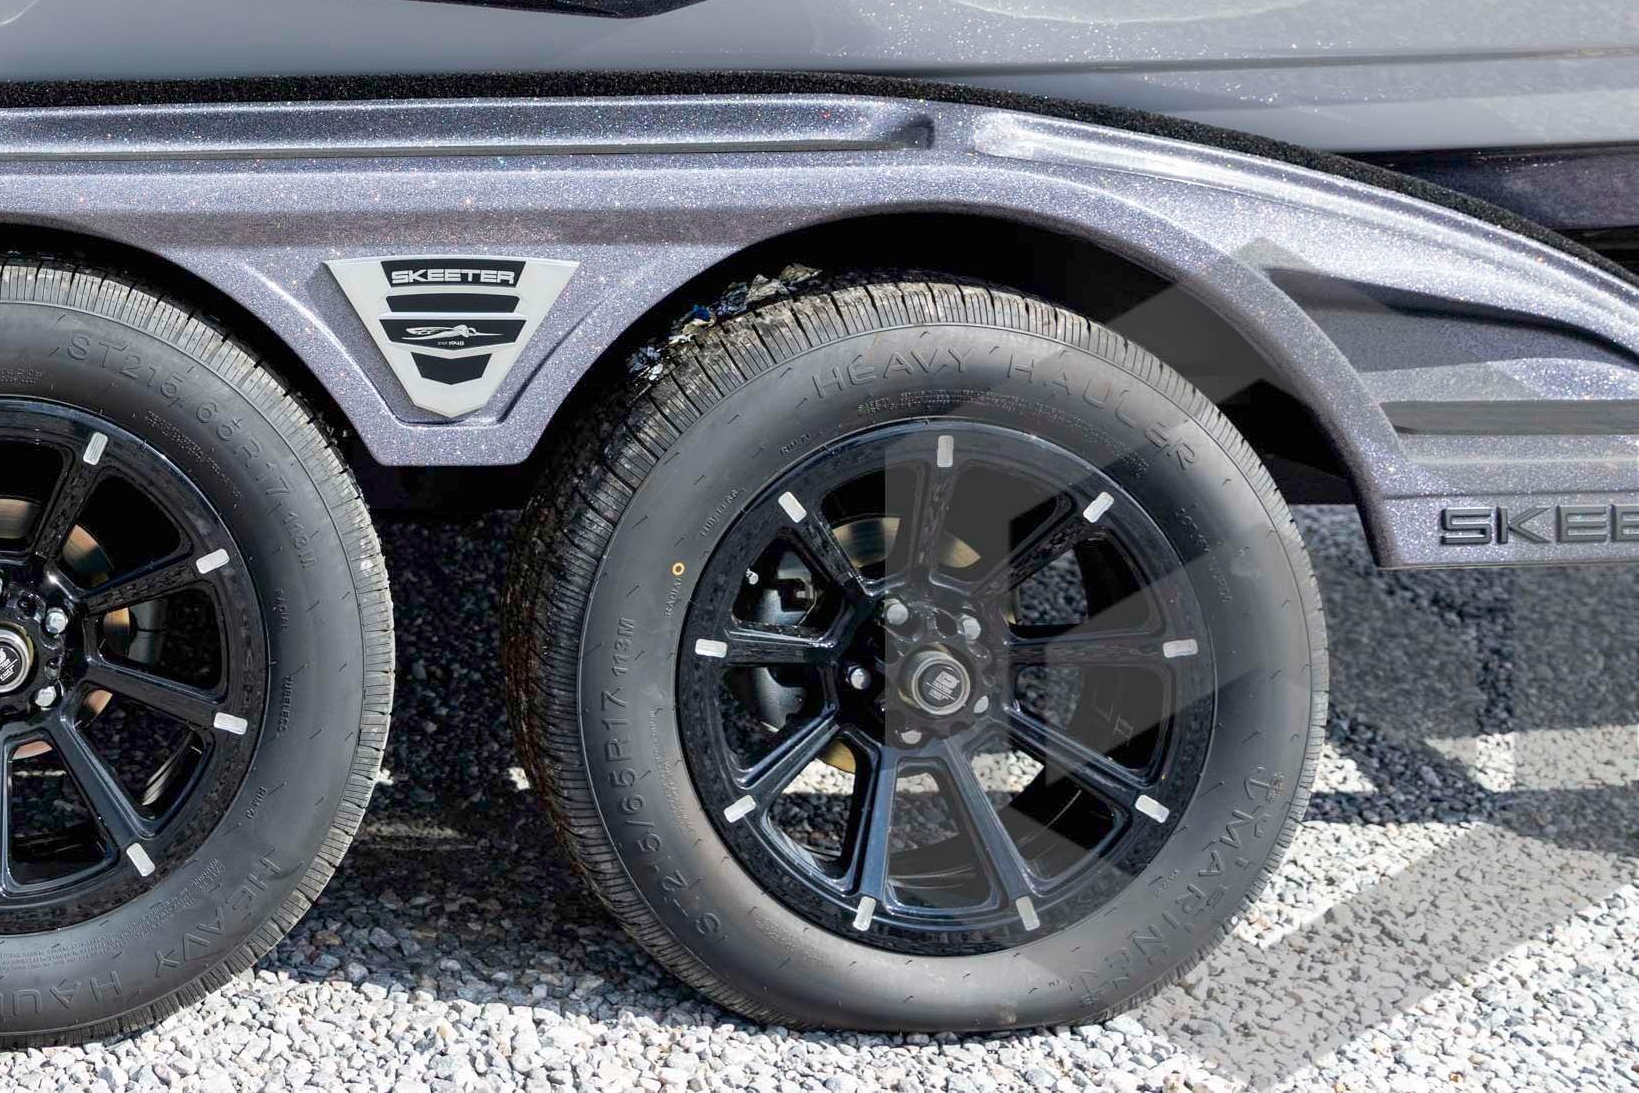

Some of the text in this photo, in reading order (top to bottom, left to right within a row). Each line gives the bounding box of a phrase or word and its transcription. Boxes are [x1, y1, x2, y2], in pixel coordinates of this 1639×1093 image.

[391, 269, 515, 285] SKEETER
[811, 347, 971, 399] HEAVY
[1006, 353, 1196, 471] HAULER
[154, 856, 282, 979] HEAVY
